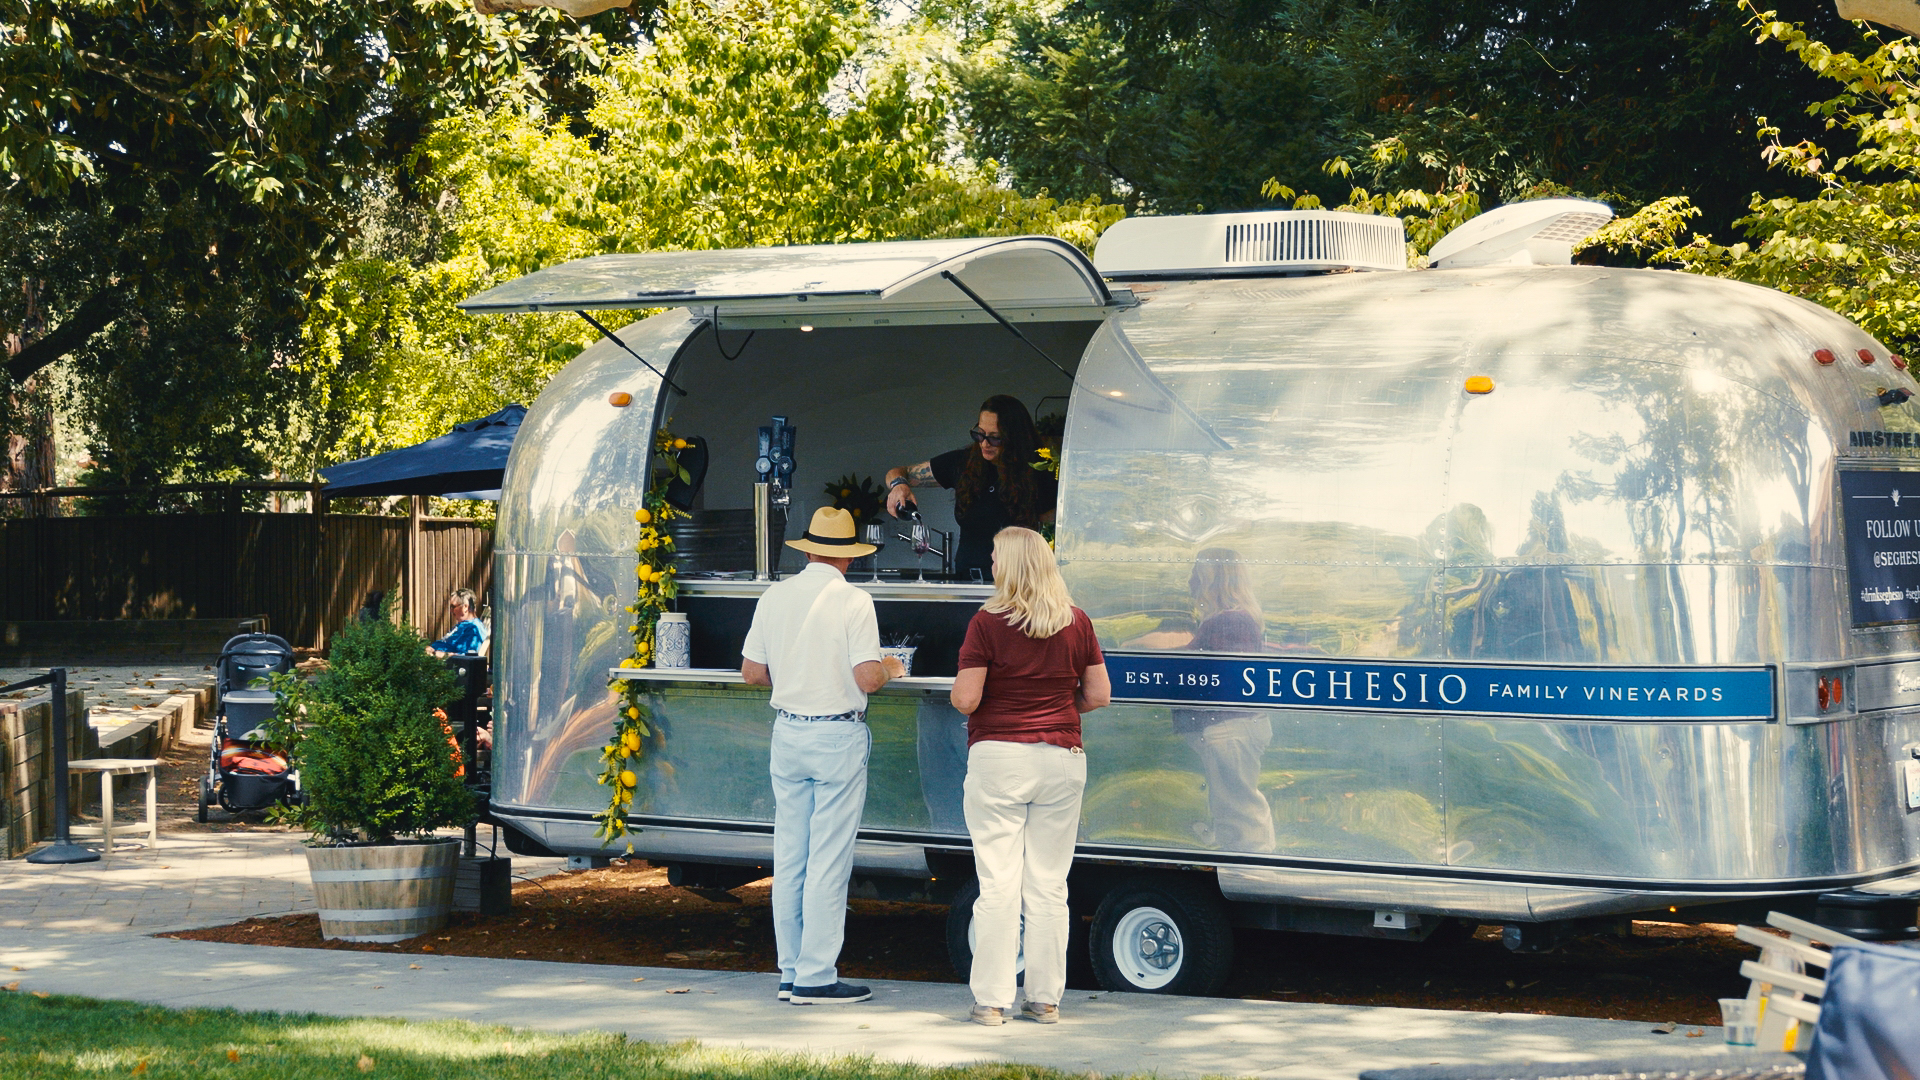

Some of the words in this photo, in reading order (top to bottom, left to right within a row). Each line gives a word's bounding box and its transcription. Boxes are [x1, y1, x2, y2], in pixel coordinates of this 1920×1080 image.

[1866, 519, 1911, 538] FOLLOW
[1860, 586, 1904, 605] #drinkseghesio
[1125, 671, 1169, 685] EST.
[1178, 673, 1221, 687] 1895
[1242, 667, 1467, 704] SEGHESIO
[1489, 683, 1569, 700] FAMILY
[1583, 686, 1723, 702] VINEYARDS
